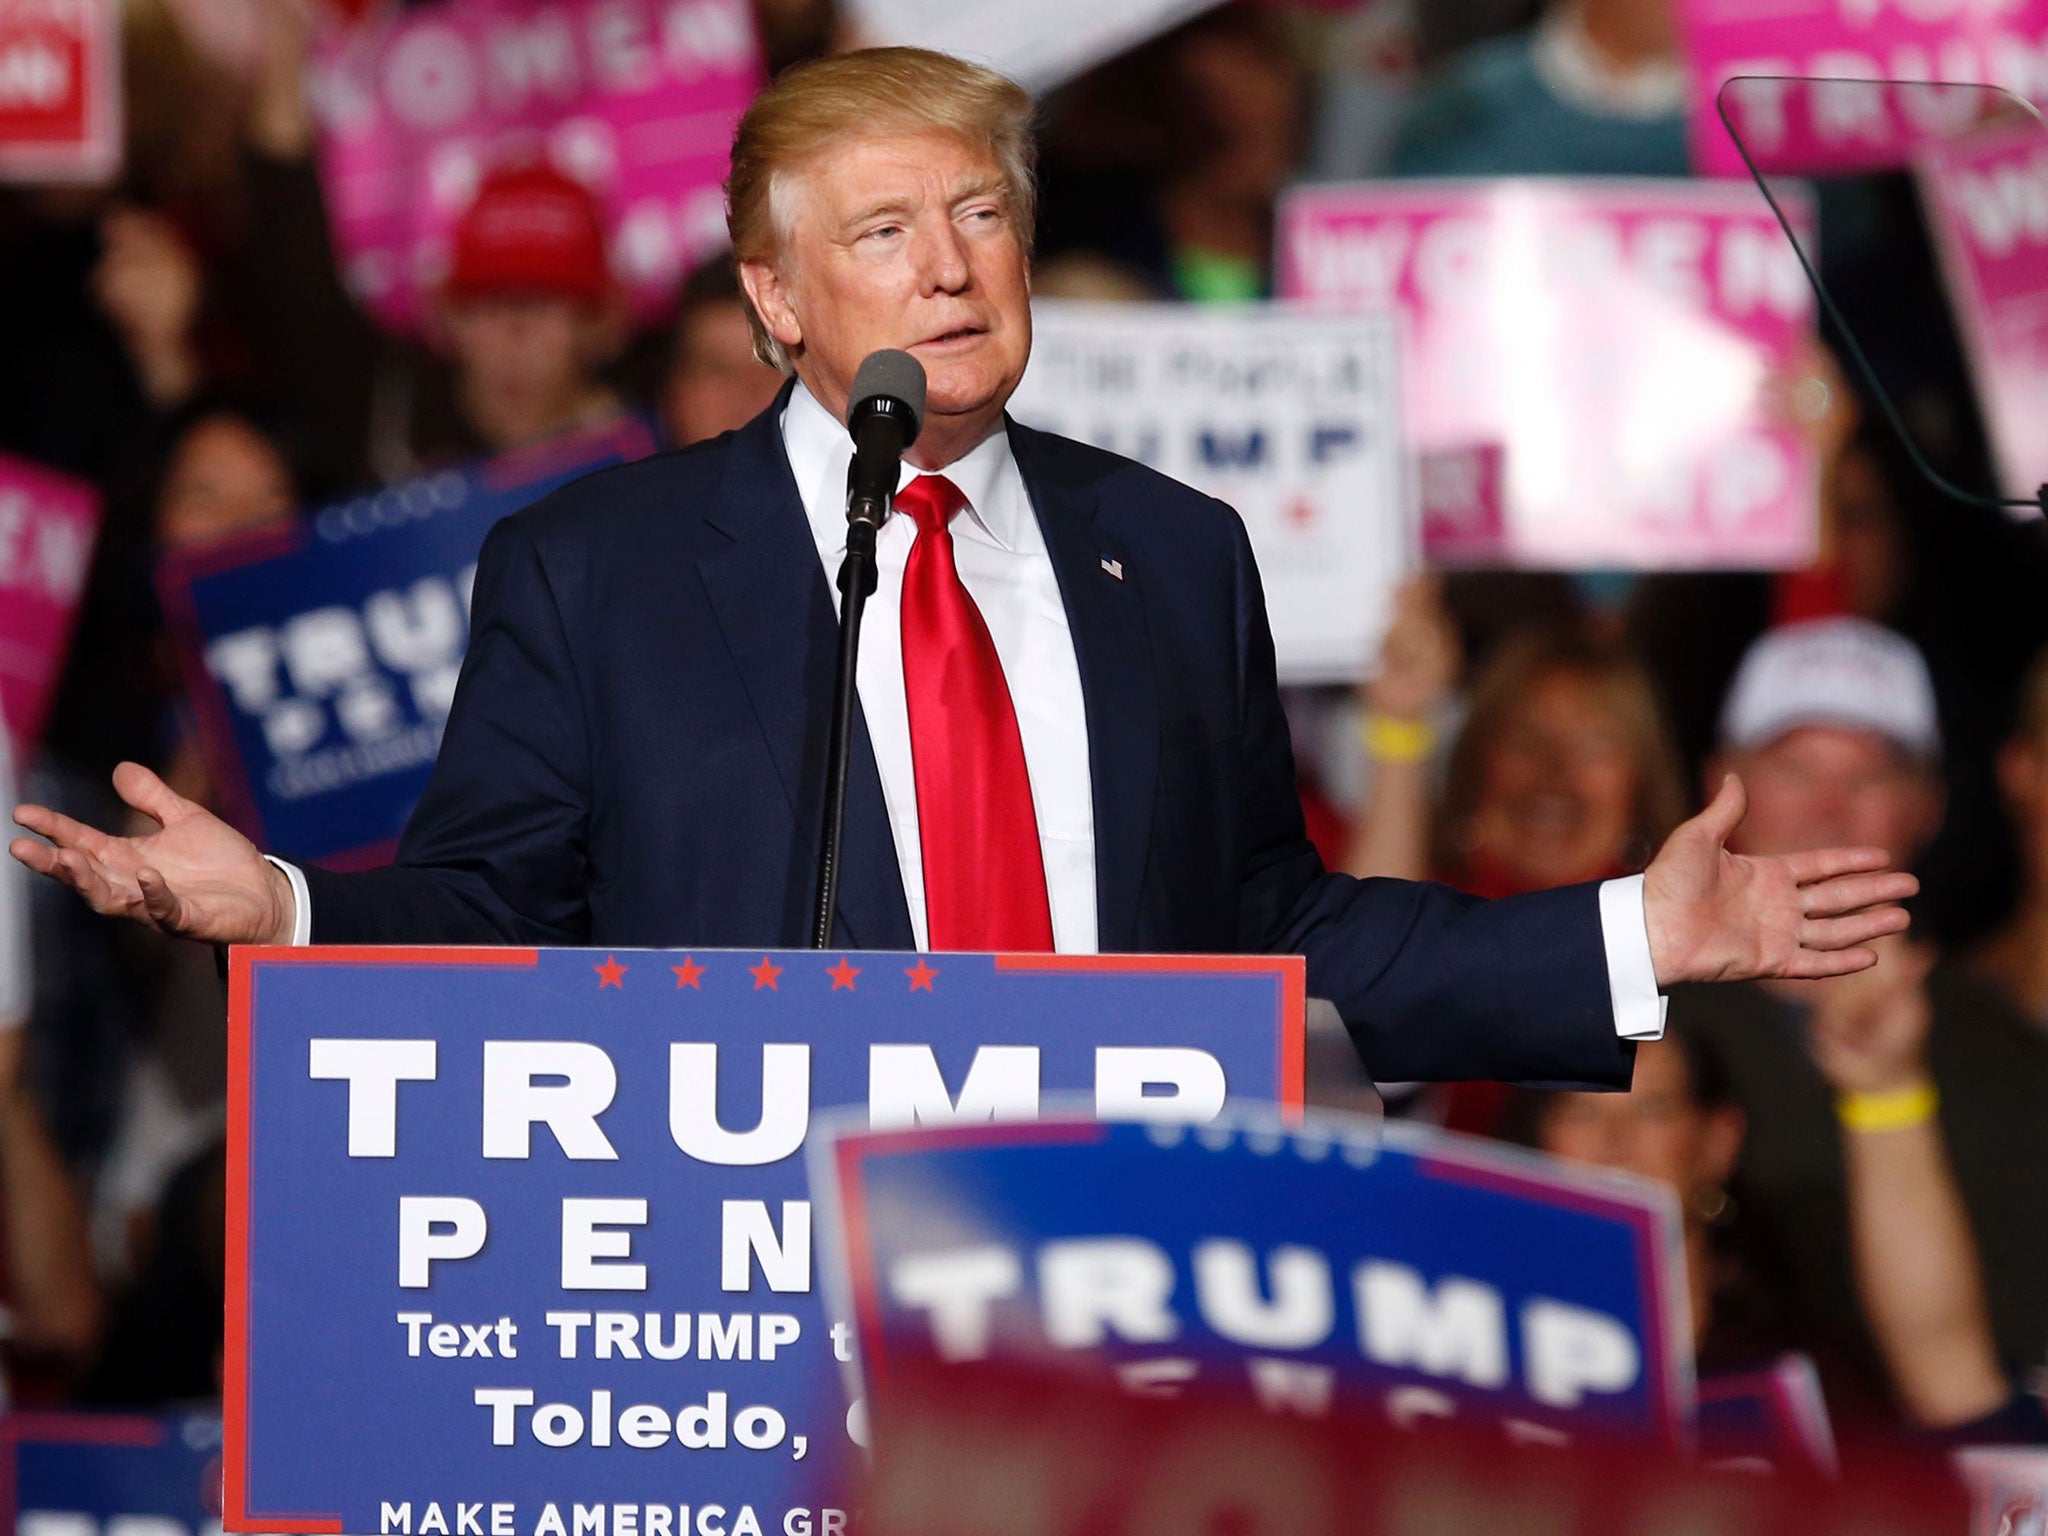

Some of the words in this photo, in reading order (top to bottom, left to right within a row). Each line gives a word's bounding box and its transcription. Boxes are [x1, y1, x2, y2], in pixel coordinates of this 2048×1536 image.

[1298, 212, 1812, 318] WOEN
[309, 1038, 1228, 1166] TRUMP
[397, 1312, 518, 1359] Text
[545, 1311, 801, 1362] TRUMP
[885, 1234, 1642, 1408] TRUMP
[474, 1388, 809, 1460] Toledo,
[379, 1502, 516, 1536] MAKE
[533, 1503, 763, 1536] AMERICA
[782, 1507, 849, 1536] GR
